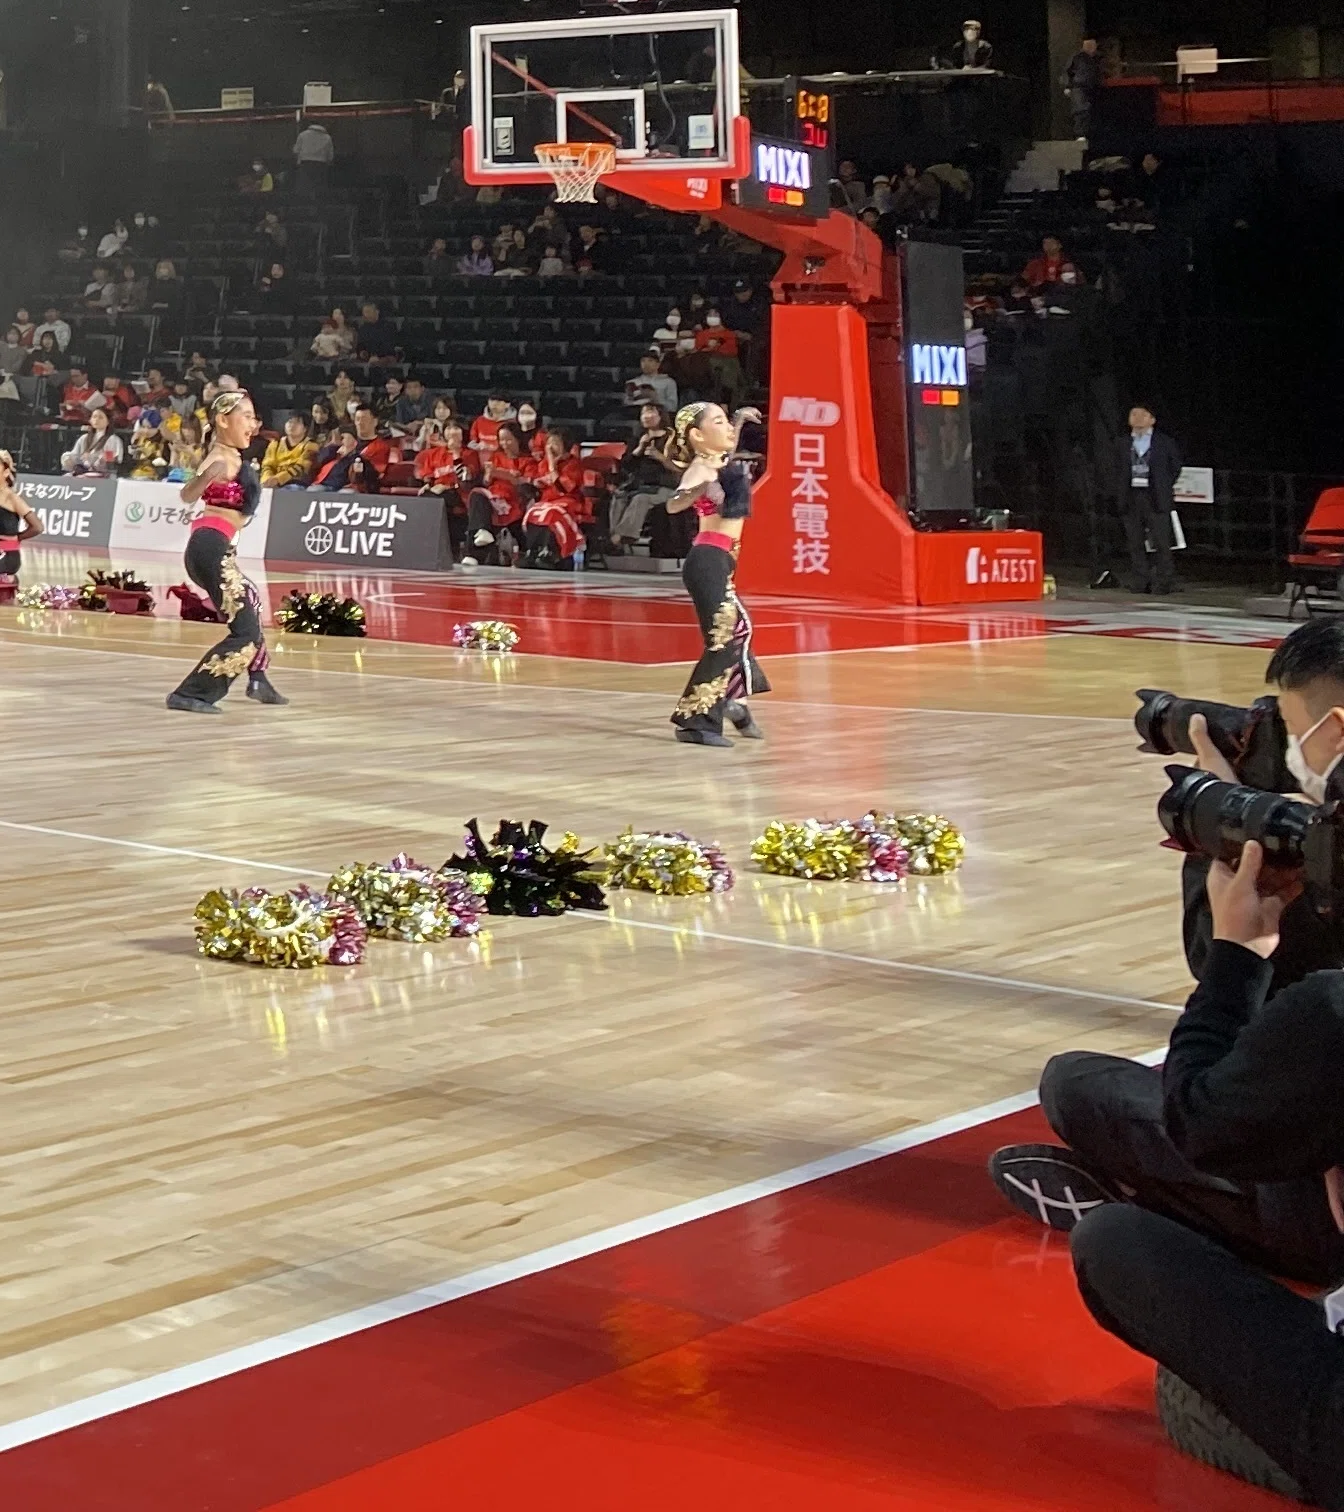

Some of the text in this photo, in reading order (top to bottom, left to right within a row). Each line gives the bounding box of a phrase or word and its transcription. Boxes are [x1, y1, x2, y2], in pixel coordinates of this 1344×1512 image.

[757, 143, 810, 189] MIXI
[912, 344, 967, 385] MIXI
[301, 501, 407, 528] バスケット
[791, 433, 830, 575] 日本電技
[19, 508, 92, 538] AGUE
[334, 529, 394, 557] LIVE
[991, 559, 1036, 583] AZEST
